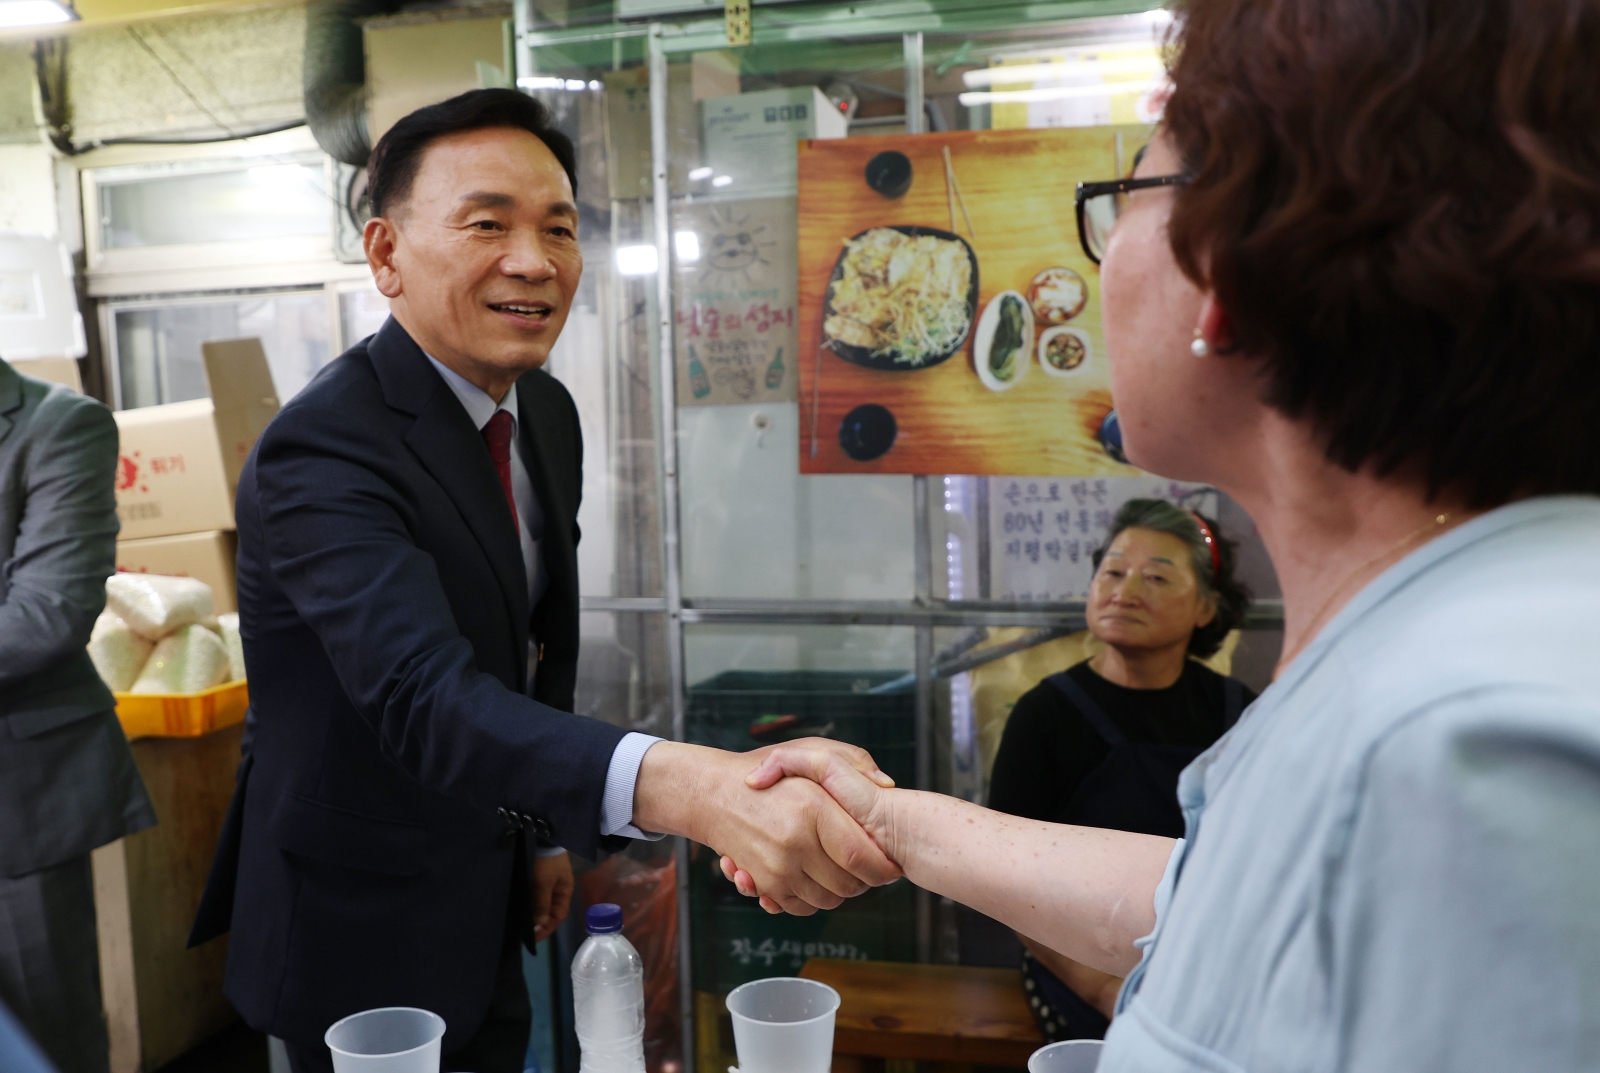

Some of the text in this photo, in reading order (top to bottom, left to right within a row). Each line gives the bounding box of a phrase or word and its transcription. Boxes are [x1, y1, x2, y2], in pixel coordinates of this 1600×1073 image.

[1004, 480, 1107, 506] 손으로 만든
[1004, 510, 1044, 534] 80년
